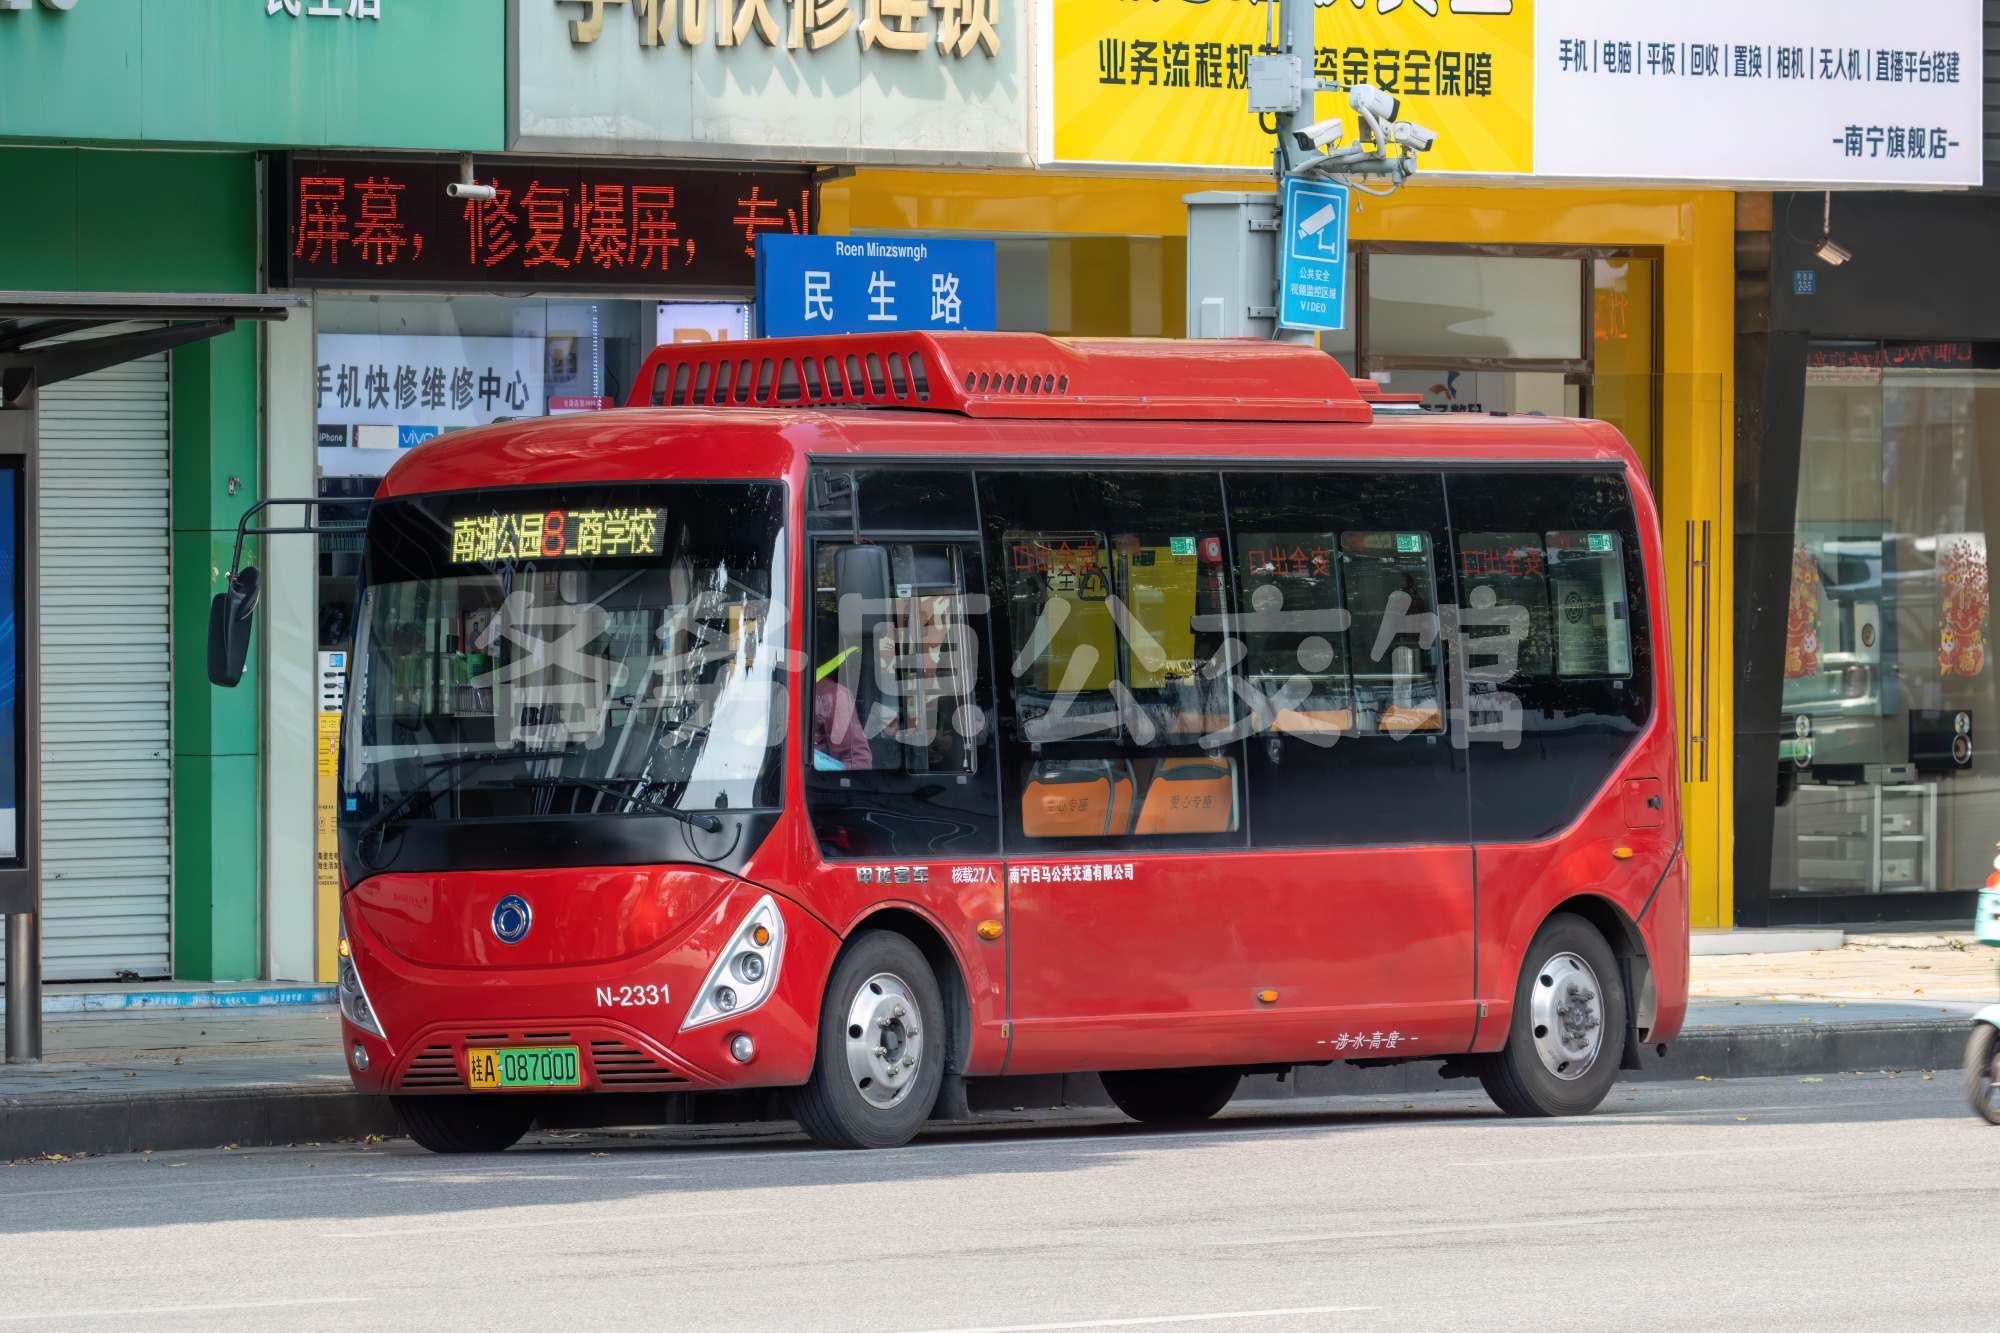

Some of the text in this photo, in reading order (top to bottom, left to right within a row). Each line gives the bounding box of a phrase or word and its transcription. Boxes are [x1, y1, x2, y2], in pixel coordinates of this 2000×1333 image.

[1098, 38, 1280, 91] 业务流程规
[836, 241, 927, 262] Roen Minzswngh
[1299, 267, 1330, 282] 公共安全
[804, 270, 966, 324] 民生路
[1290, 283, 1337, 299] 视频监控区域
[1301, 300, 1326, 313] VIDEO
[318, 432, 343, 442] iPhone
[542, 510, 564, 557] 8
[1169, 795, 1213, 810] 爱心专座
[856, 866, 929, 885] 申龙客车
[951, 866, 997, 884] 核载27人
[1009, 863, 1134, 884] 南宁白马公共交通有限公司
[596, 984, 670, 1007] N-2331
